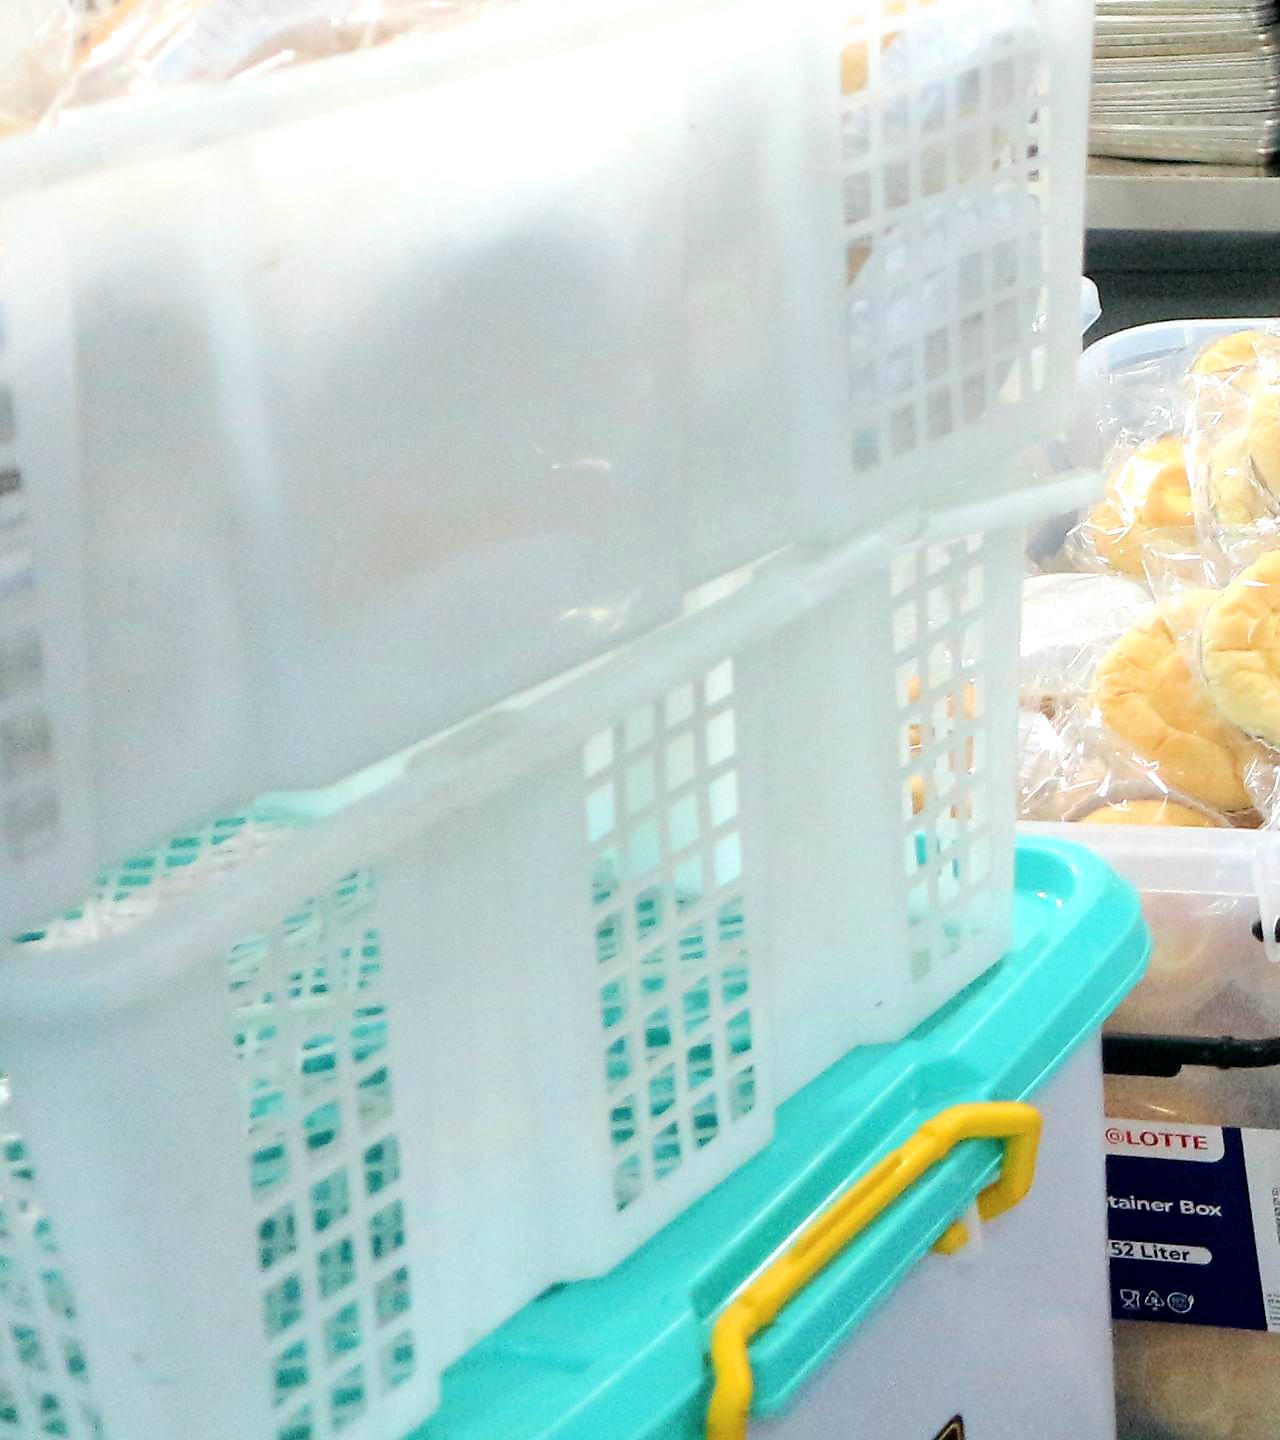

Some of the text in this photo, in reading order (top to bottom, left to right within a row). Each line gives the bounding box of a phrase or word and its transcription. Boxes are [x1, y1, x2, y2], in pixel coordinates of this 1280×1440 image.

[1126, 1130, 1209, 1150] LOTTE
[1107, 1195, 1222, 1217] tainer Box
[1110, 1241, 1190, 1261] 52 Liter
